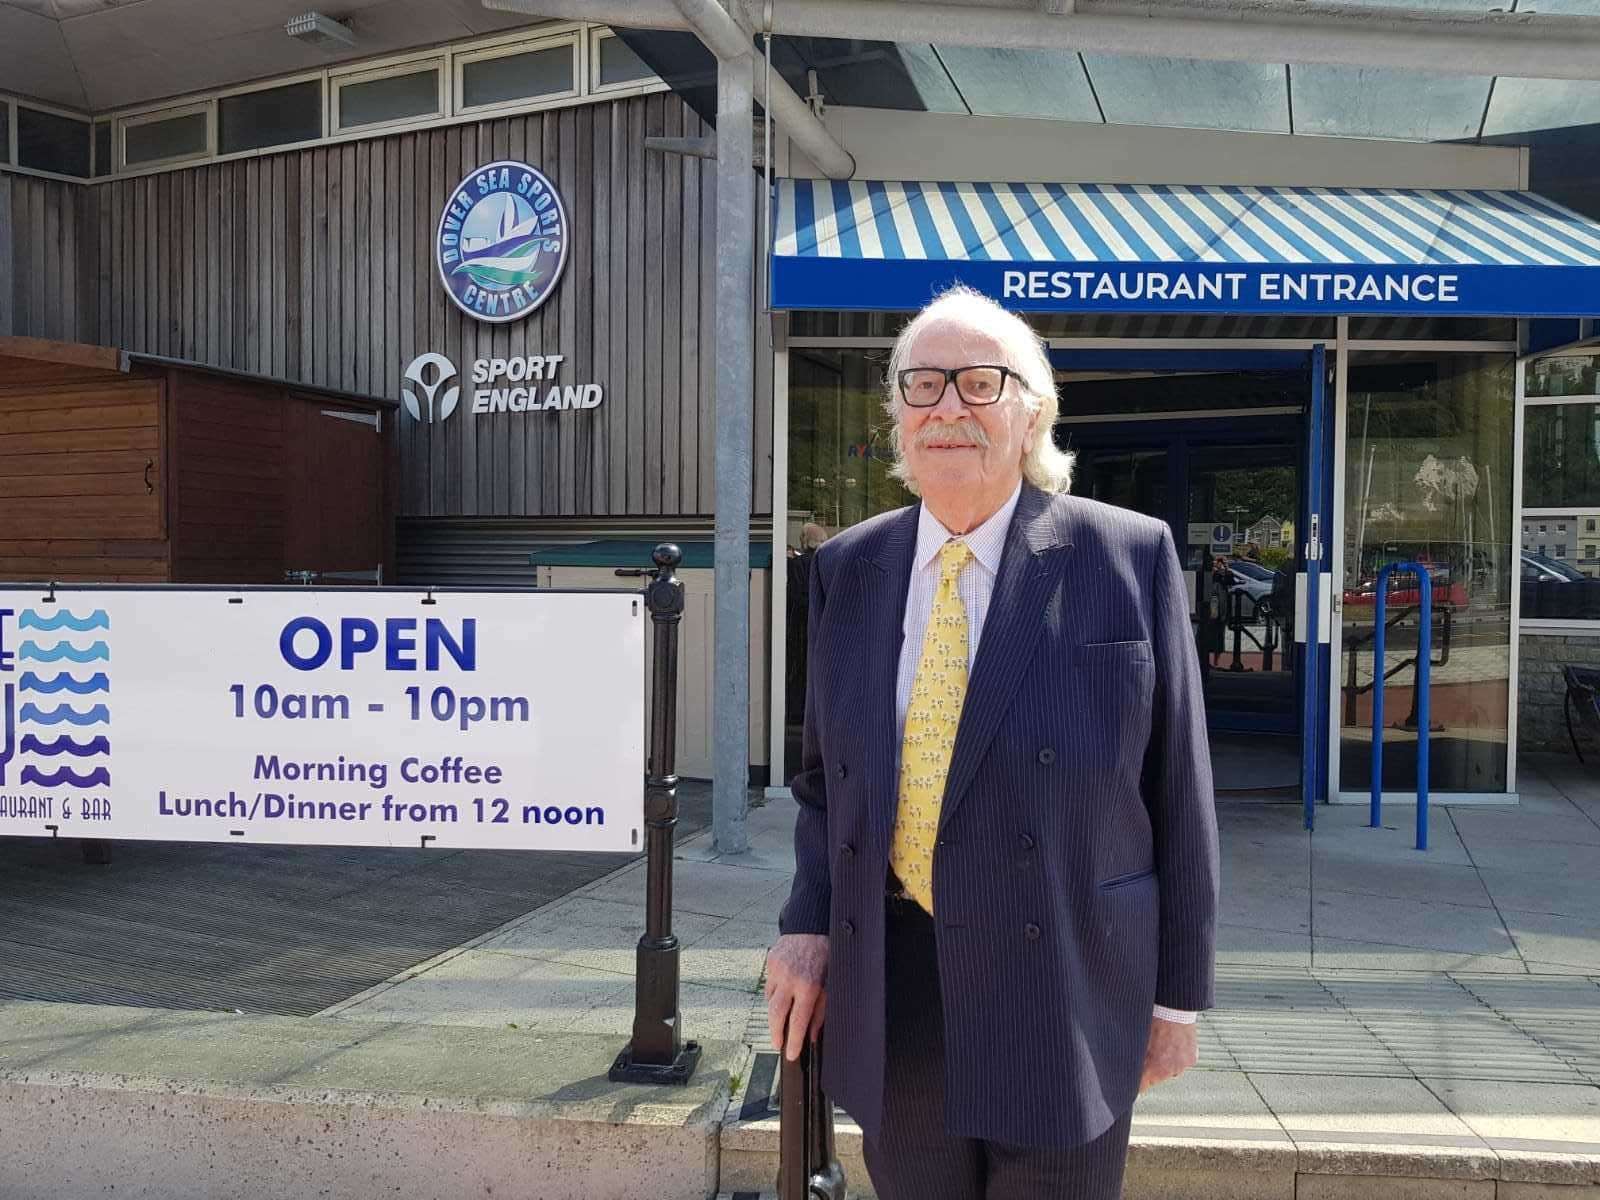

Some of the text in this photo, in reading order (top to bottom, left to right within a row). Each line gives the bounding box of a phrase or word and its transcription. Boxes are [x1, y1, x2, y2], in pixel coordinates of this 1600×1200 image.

[443, 168, 561, 264] DOVER SEA SPORTS
[463, 279, 538, 315] CENTRE
[1003, 270, 1459, 302] RESTAURANT ENTRANCE
[472, 355, 564, 383] SPORT
[472, 384, 603, 413] ENGLAND
[280, 616, 475, 672] OPEN
[230, 684, 529, 731] 10am - 10pm
[254, 754, 503, 788] Morning Coffee
[63, 797, 73, 820] &
[81, 797, 111, 821] BAR
[160, 790, 605, 826] Lunch/Dinner from 12 noon
